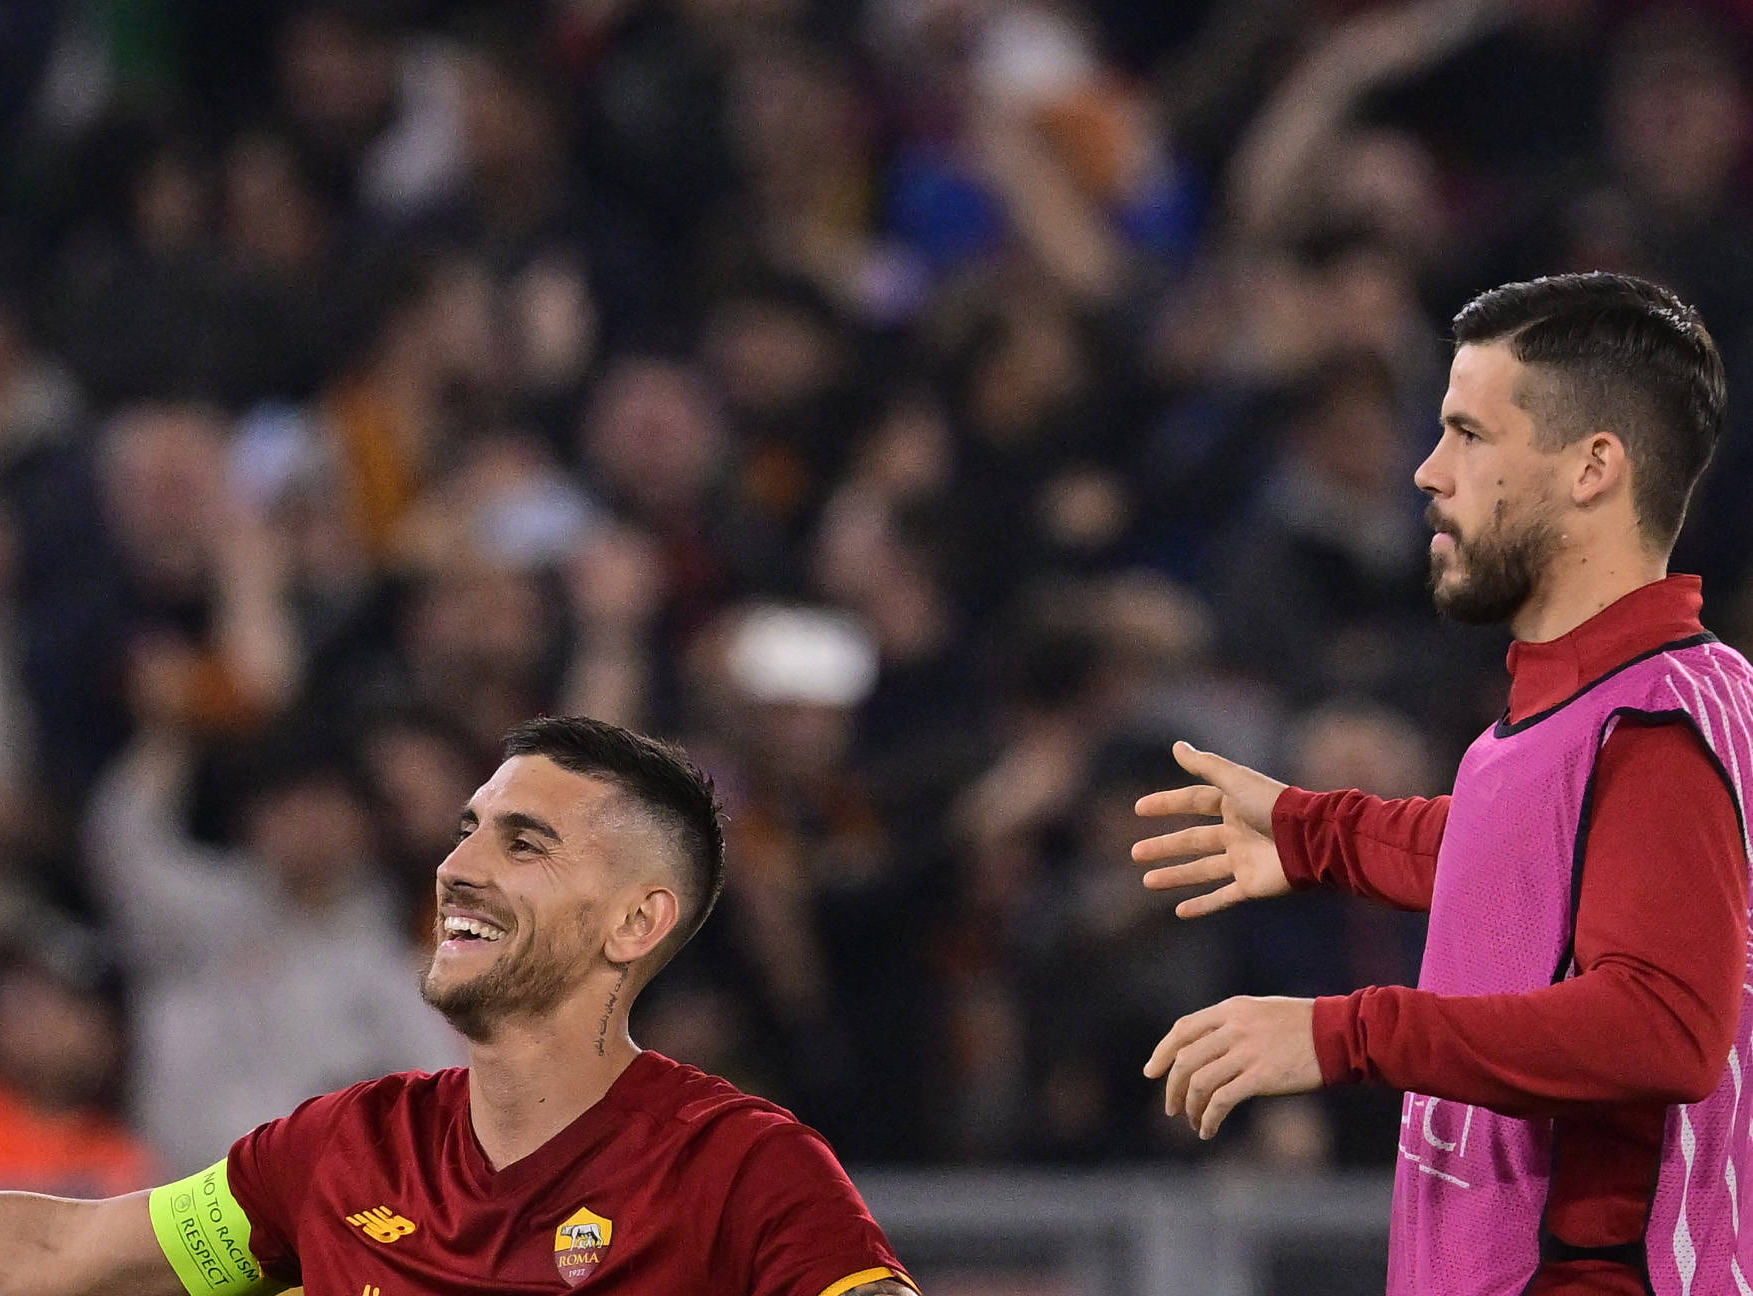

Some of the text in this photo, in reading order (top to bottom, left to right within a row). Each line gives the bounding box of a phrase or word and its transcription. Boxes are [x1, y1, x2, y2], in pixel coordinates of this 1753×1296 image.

[203, 1172, 260, 1282] NO TO RACISM
[181, 1218, 230, 1285] RESPECT
[558, 1252, 600, 1268] ROMA
[568, 1268, 586, 1278] 1927
